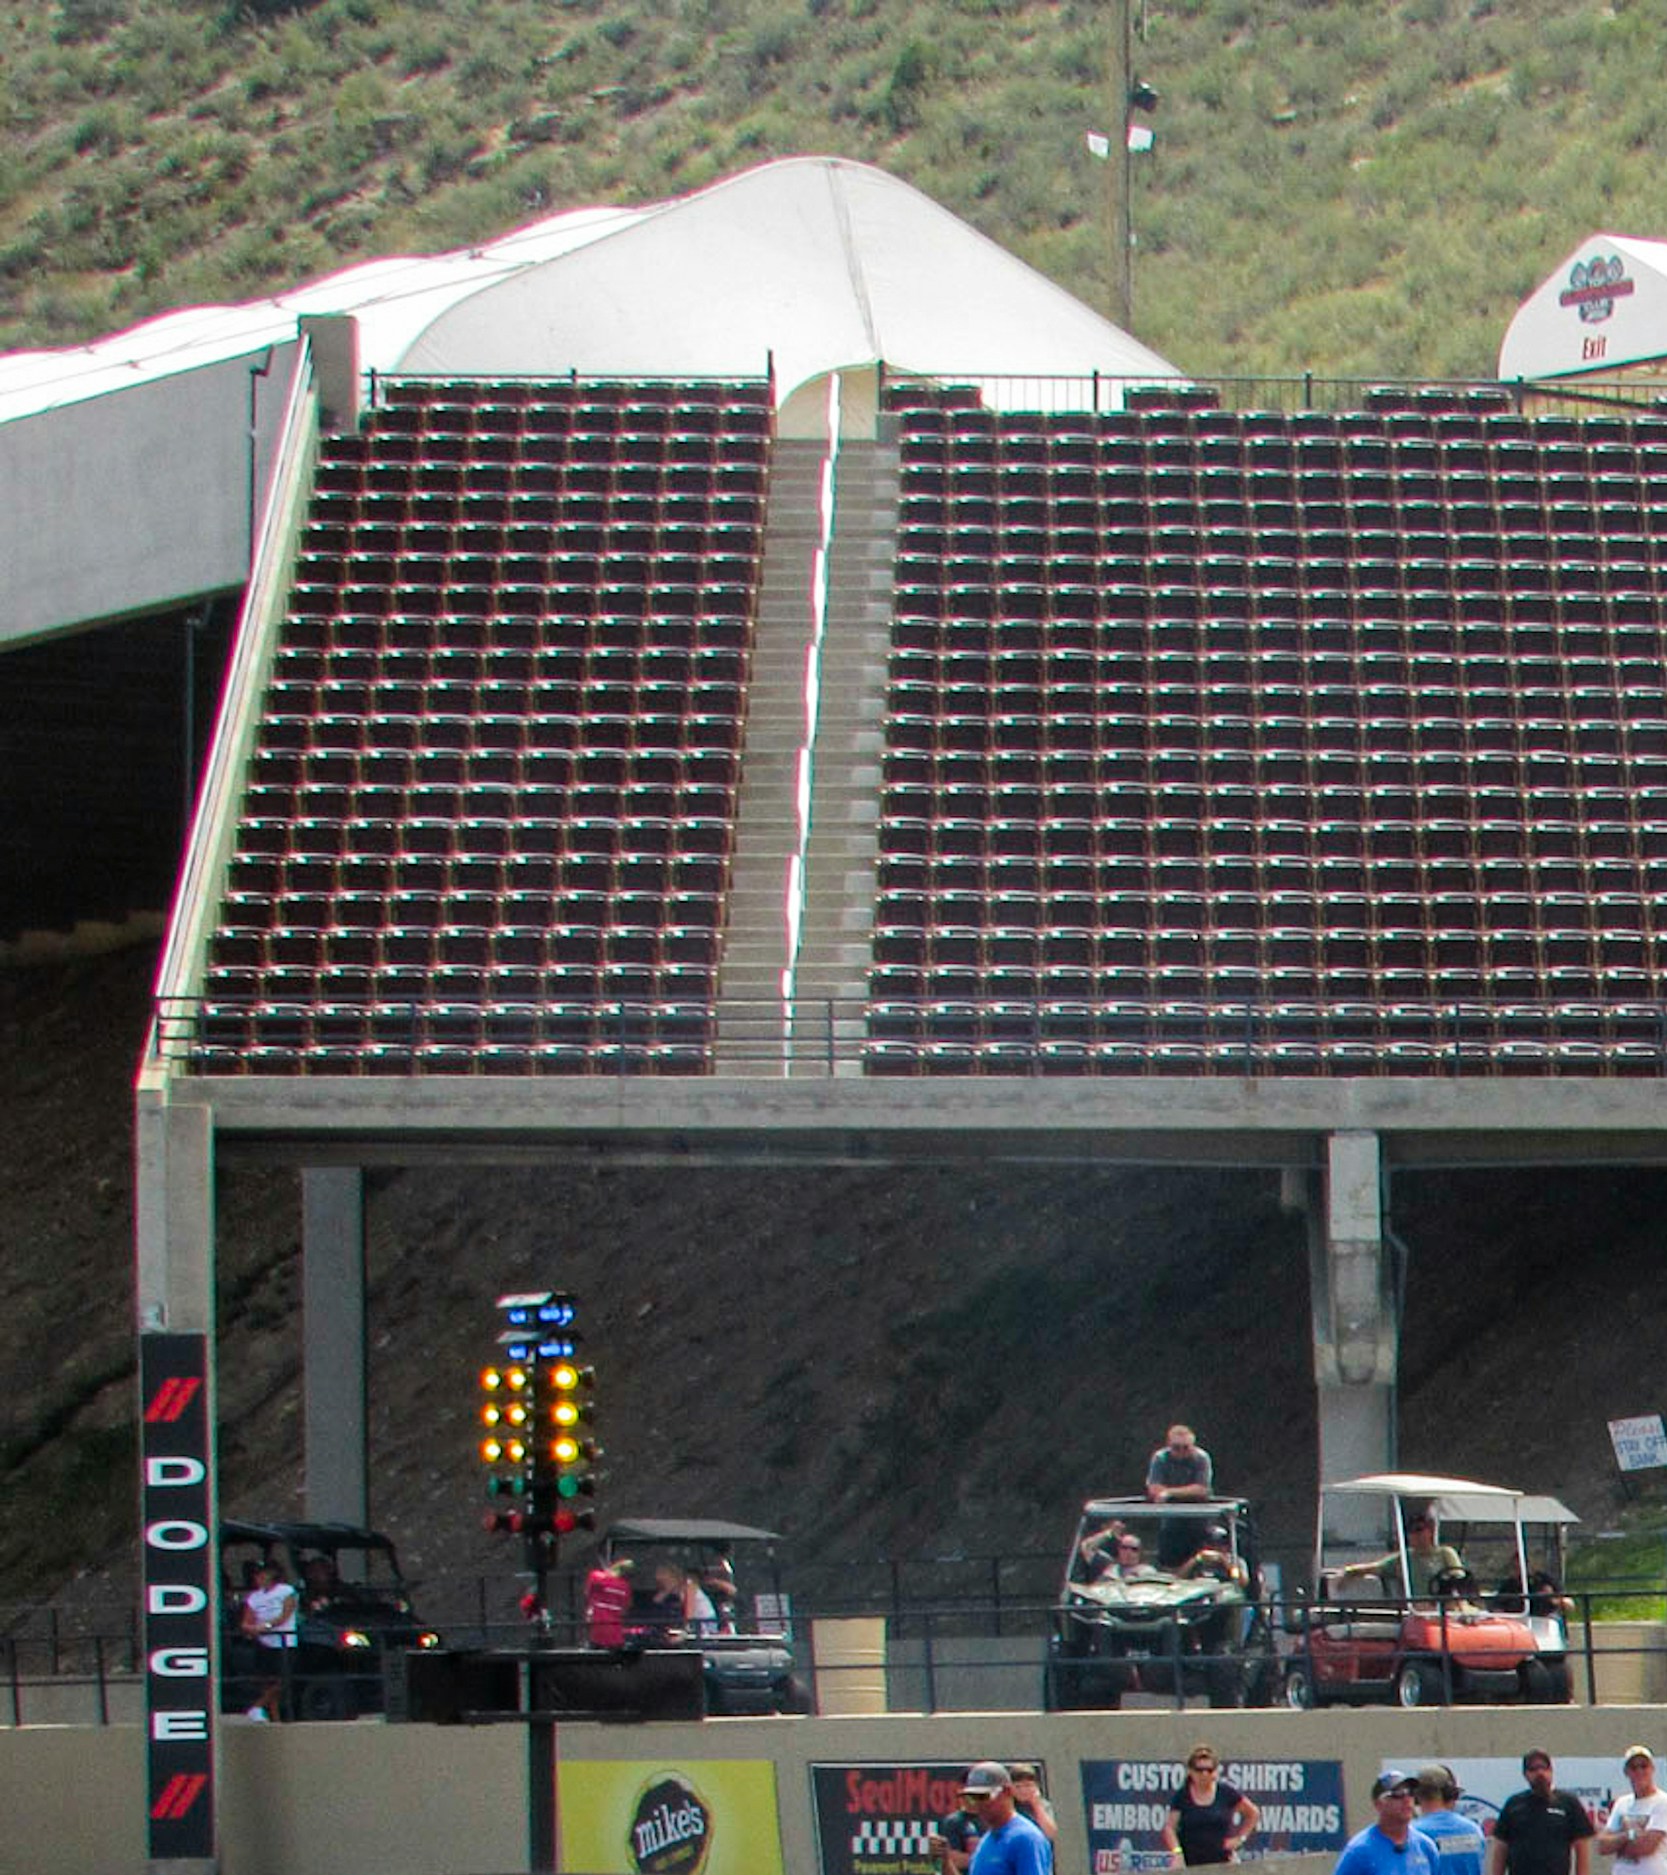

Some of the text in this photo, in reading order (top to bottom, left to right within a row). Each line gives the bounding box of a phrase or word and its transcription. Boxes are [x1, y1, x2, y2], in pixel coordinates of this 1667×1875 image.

[1582, 335, 1607, 361] Exit
[145, 1456, 208, 1741] DODGE
[1117, 1763, 1185, 1792] CUSTO
[635, 1799, 705, 1859] mike's
